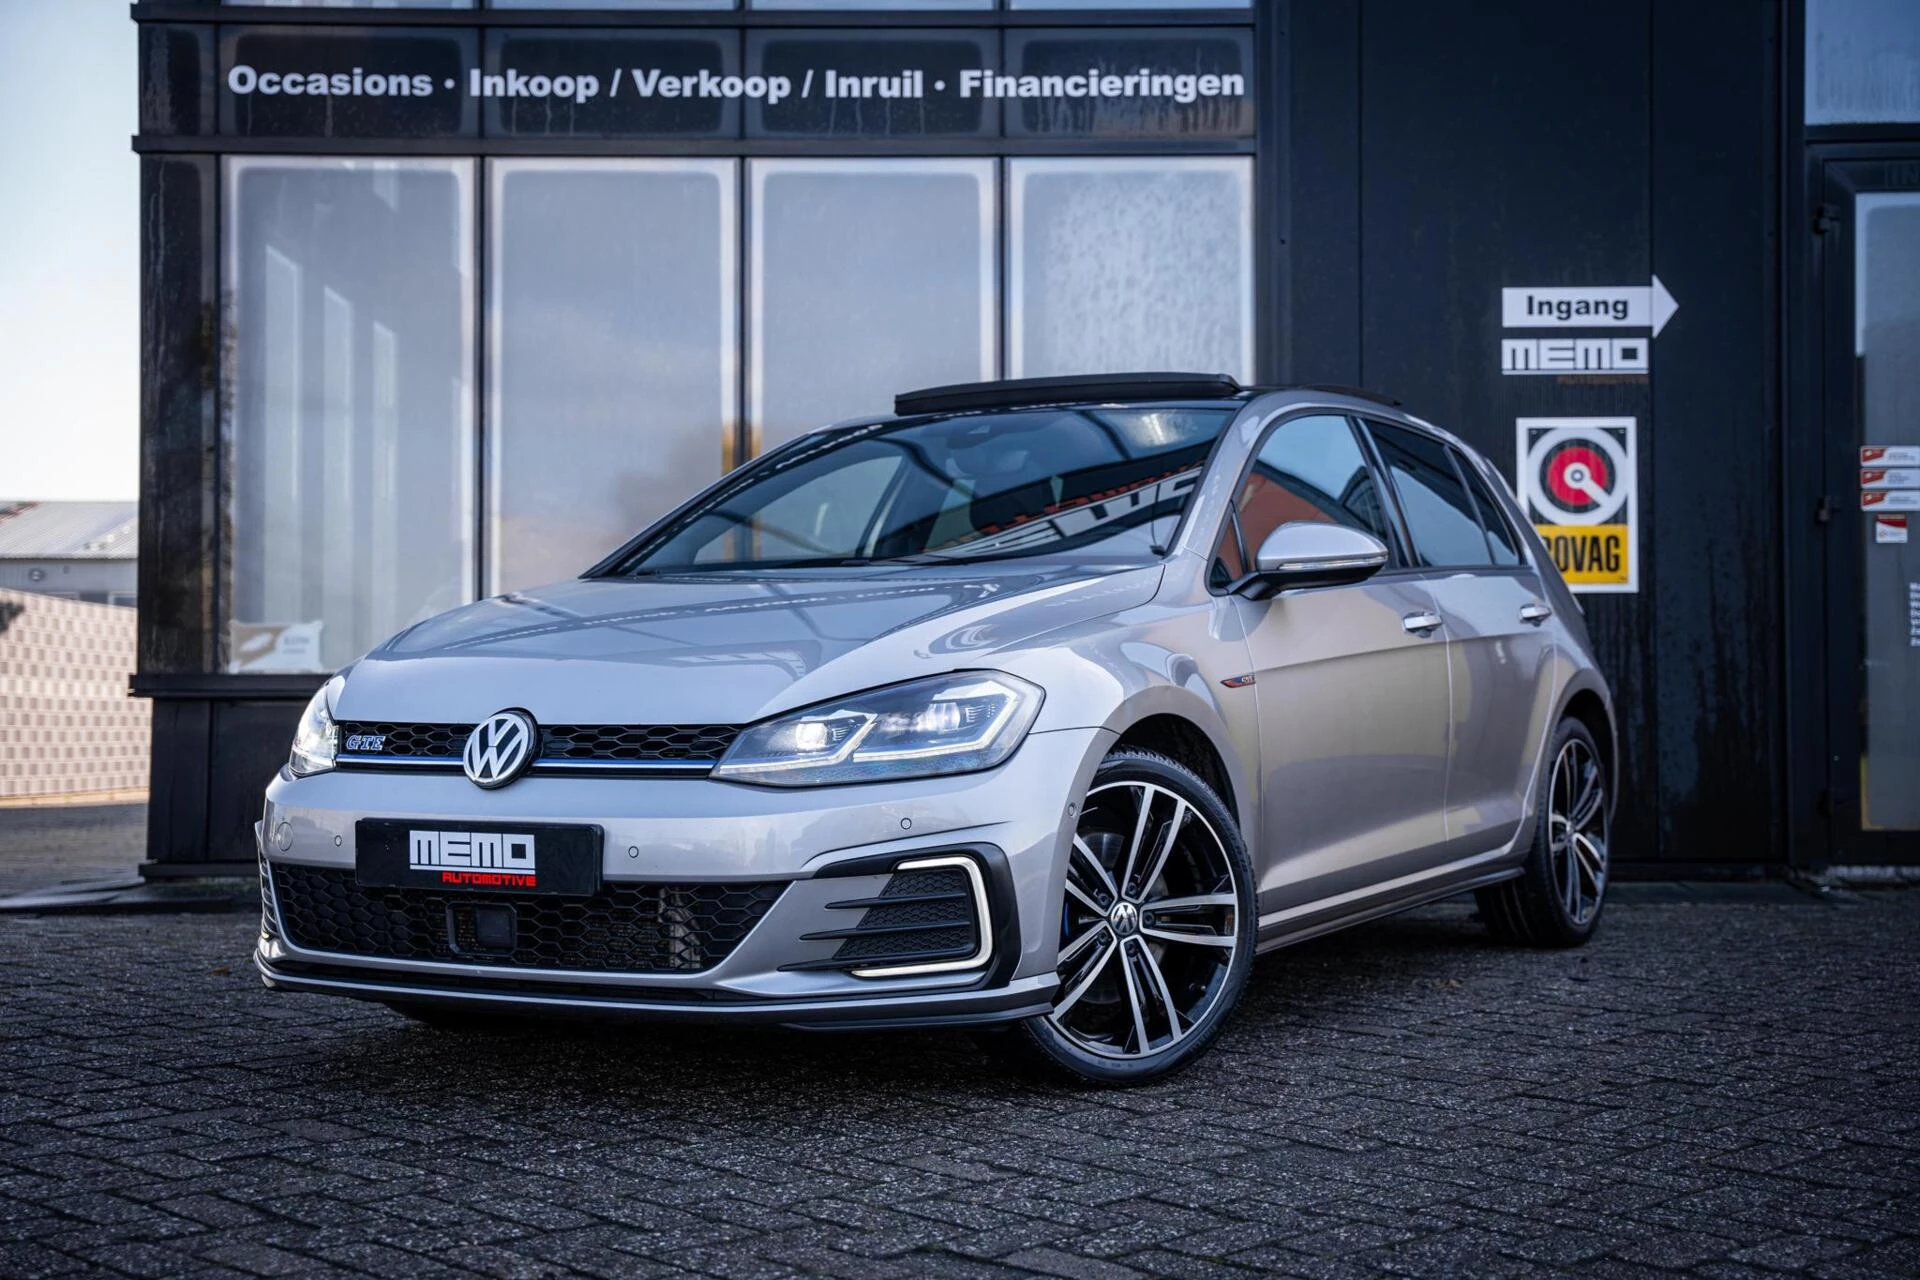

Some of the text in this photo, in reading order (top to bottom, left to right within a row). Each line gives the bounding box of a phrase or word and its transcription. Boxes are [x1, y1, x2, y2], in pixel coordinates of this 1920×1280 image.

[227, 65, 433, 96] Occasions
[469, 68, 599, 103] Inkoop
[632, 69, 791, 104] Verkoop
[825, 70, 923, 98] Inruil
[960, 68, 1244, 103] Financieringen
[1526, 295, 1629, 320] Ingang
[1502, 338, 1648, 371] MEMO
[346, 735, 386, 751] GTE
[409, 830, 535, 870] MEMO
[442, 871, 537, 888] AUTOMOTIVE
